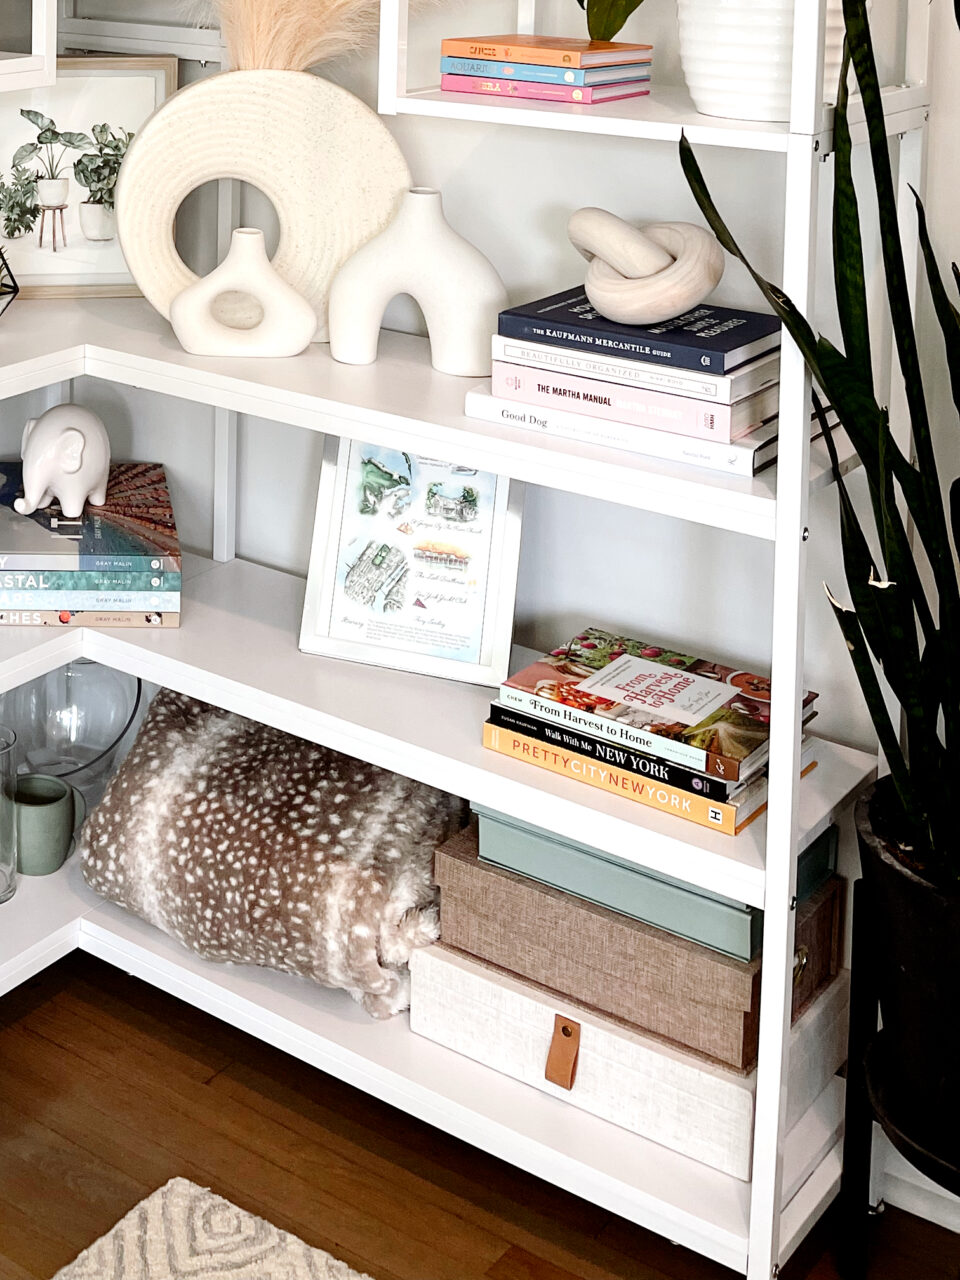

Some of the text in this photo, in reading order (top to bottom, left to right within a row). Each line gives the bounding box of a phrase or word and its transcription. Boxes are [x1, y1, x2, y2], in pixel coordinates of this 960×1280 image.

[545, 329, 593, 344] KAUFMANN
[595, 337, 651, 355] MERCANTILE
[652, 349, 671, 358] GUIDE
[520, 349, 640, 379] BEAUTIFULLY ORGANIZED
[537, 383, 550, 394] THE
[552, 387, 581, 401] MARTHA
[582, 392, 612, 406] MANUAL
[501, 409, 548, 428] Good Dog
[615, 673, 657, 693] From
[623, 672, 684, 705] Harvest
[651, 676, 695, 703] Home
[647, 696, 665, 708] to
[529, 698, 561, 717] From
[563, 710, 604, 732] Harvest
[606, 726, 617, 736] to
[619, 728, 653, 748] Home
[544, 728, 562, 741] Walk
[562, 734, 580, 747] With
[581, 740, 593, 752] Me
[596, 743, 628, 765] NEW
[629, 754, 669, 781] YORK
